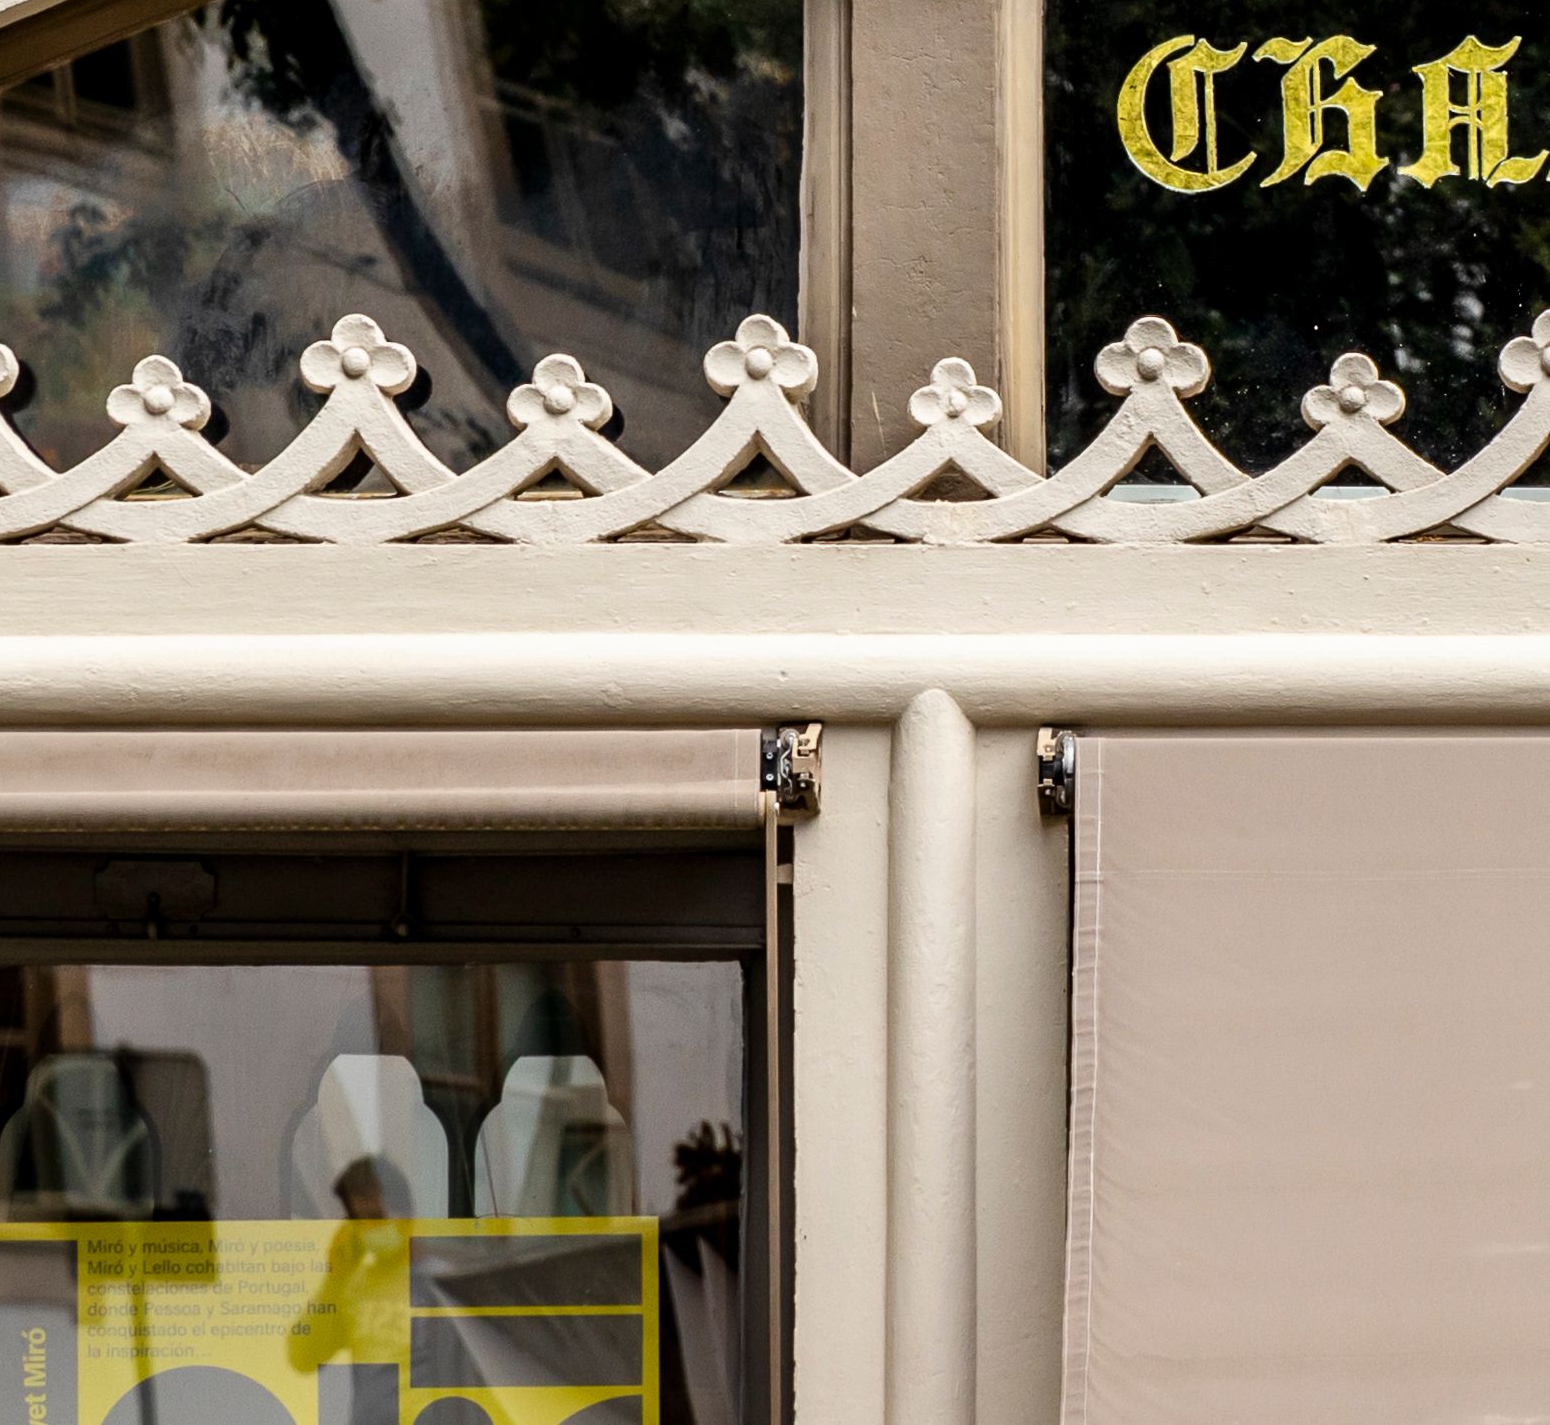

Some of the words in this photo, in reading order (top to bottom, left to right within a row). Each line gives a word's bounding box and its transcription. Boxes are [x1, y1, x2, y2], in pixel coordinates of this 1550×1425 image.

[87, 1240, 123, 1254] Miró
[130, 1244, 137, 1257] y
[142, 1240, 204, 1255] música,
[209, 1239, 244, 1253] Miró
[251, 1243, 259, 1256] y
[87, 1260, 123, 1275] Miró
[130, 1265, 137, 1278] y
[143, 1260, 181, 1275] Lello
[186, 1259, 265, 1275] cohabitan
[272, 1259, 306, 1276] bajo
[311, 1256, 332, 1272] las
[87, 1282, 209, 1295] constelaciones
[213, 1282, 233, 1294] de
[239, 1281, 308, 1297] Portugal,
[88, 1303, 138, 1317] donde
[144, 1304, 201, 1316] Pessoa
[207, 1308, 214, 1318] y
[221, 1303, 301, 1318] Saramago
[308, 1300, 337, 1314] han
[88, 1323, 187, 1338] conquistado
[193, 1323, 205, 1335] el
[211, 1323, 286, 1338] epicentro
[291, 1321, 310, 1335] de
[20, 1327, 47, 1387] Miró
[88, 1344, 100, 1358] la
